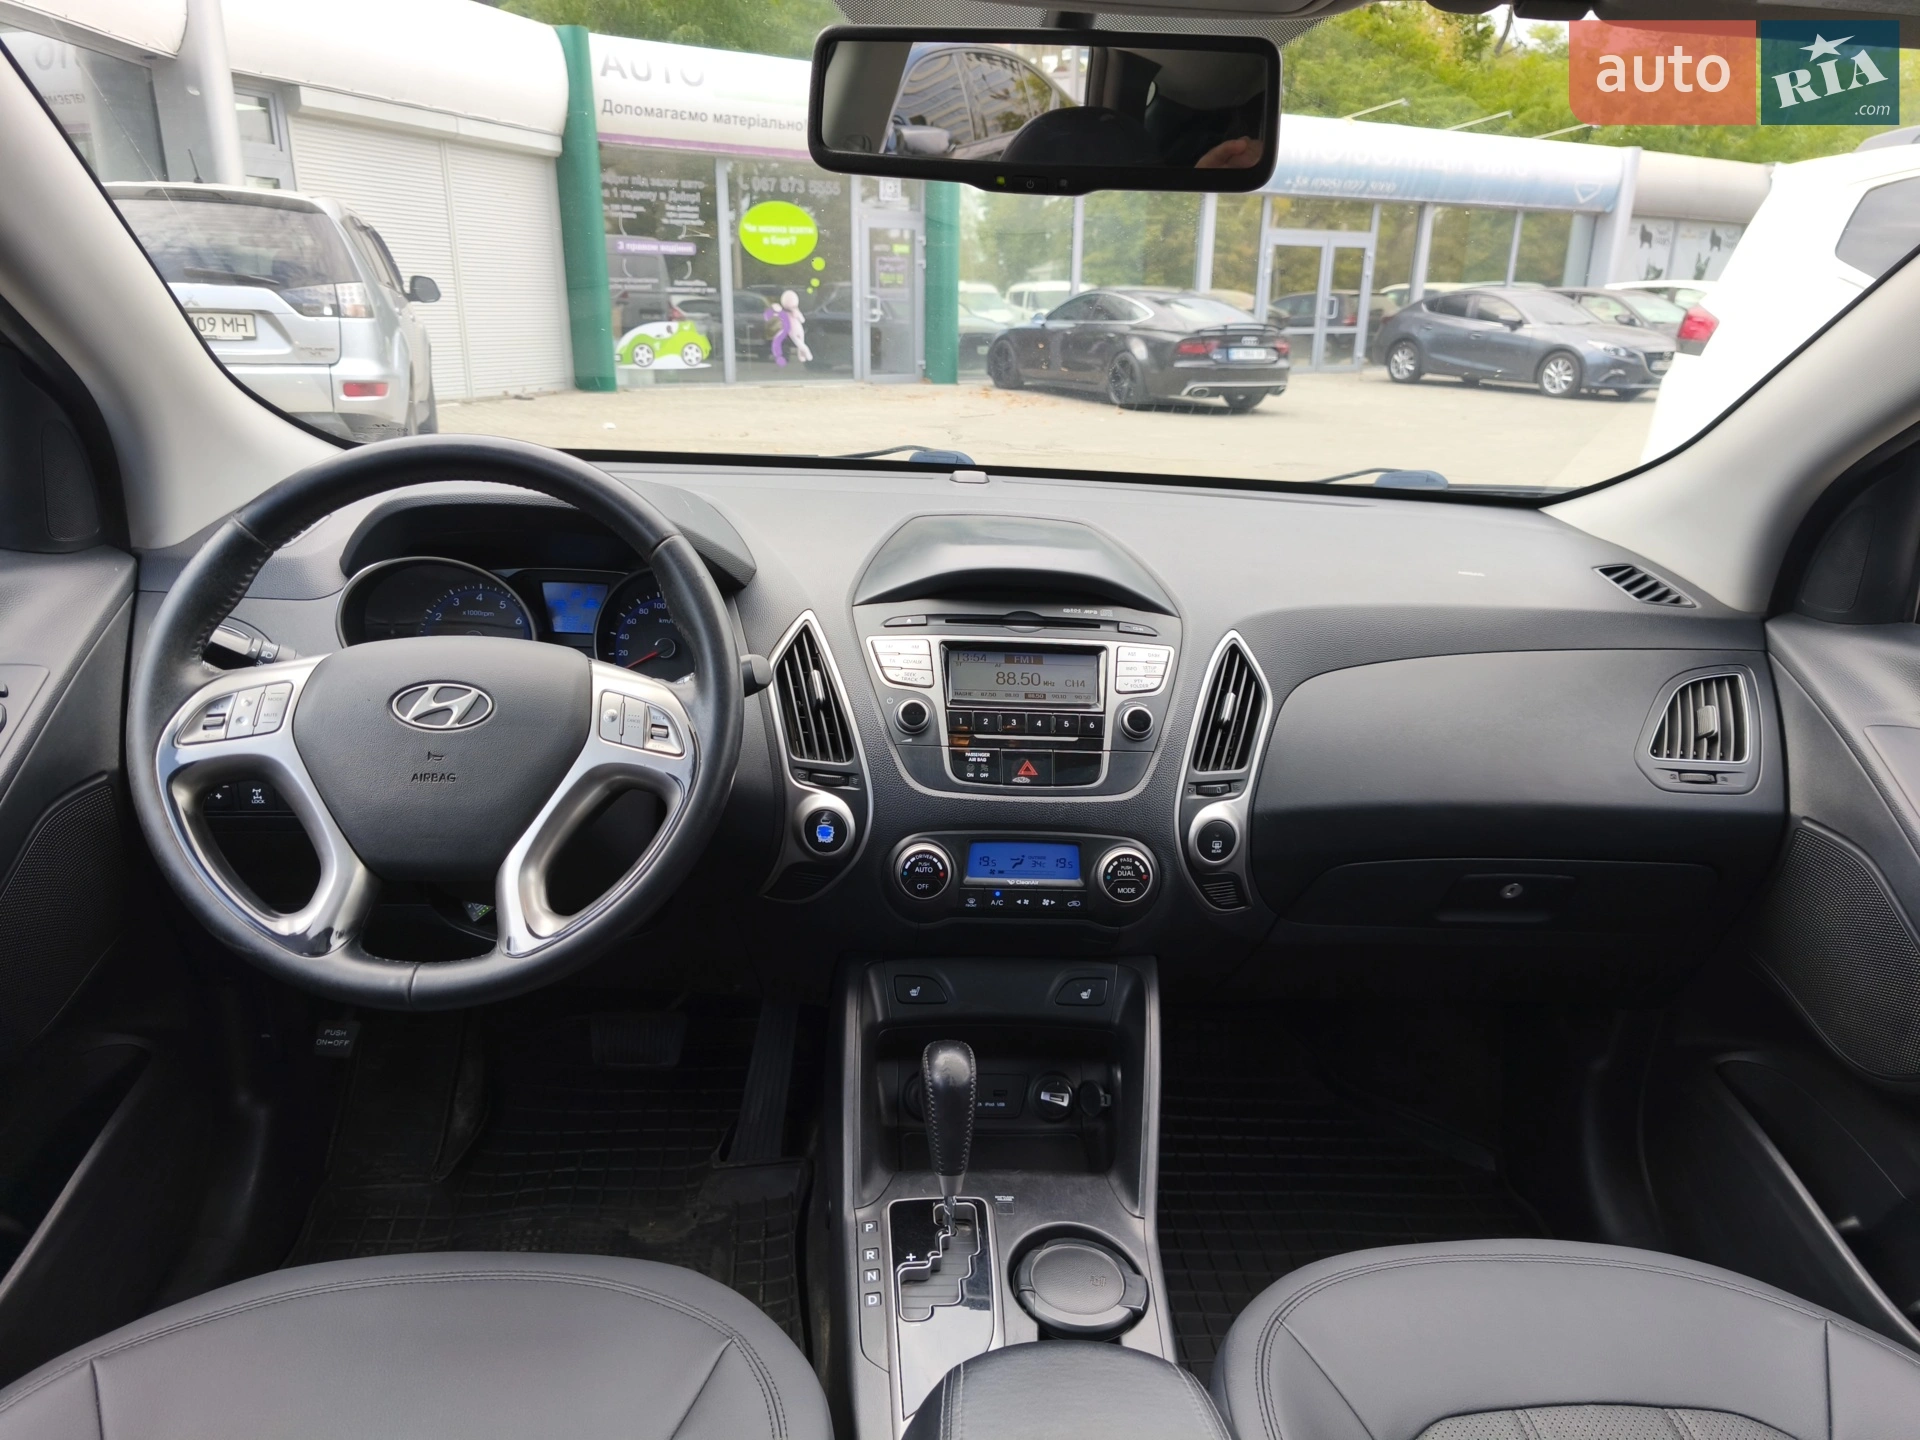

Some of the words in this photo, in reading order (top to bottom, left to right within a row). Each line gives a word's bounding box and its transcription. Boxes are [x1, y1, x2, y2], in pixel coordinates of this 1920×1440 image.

[601, 98, 708, 123] Допомагаємо
[189, 316, 216, 332] 09
[221, 316, 248, 333] MH
[453, 597, 460, 606] 3
[476, 593, 483, 601] 4
[499, 600, 507, 609] 5
[435, 612, 442, 621] 2
[515, 617, 522, 625] 6
[1013, 655, 1035, 664] FM1
[995, 671, 1041, 686] 88.50
[1064, 679, 1086, 688] CH4
[959, 717, 963, 725] 1
[411, 772, 457, 783] AIRBAG
[324, 1028, 348, 1036] PUSH
[315, 1038, 350, 1047] ON-OFF
[865, 1223, 874, 1232] P
[866, 1250, 875, 1260] R
[867, 1271, 877, 1281] N
[868, 1295, 878, 1305] D
